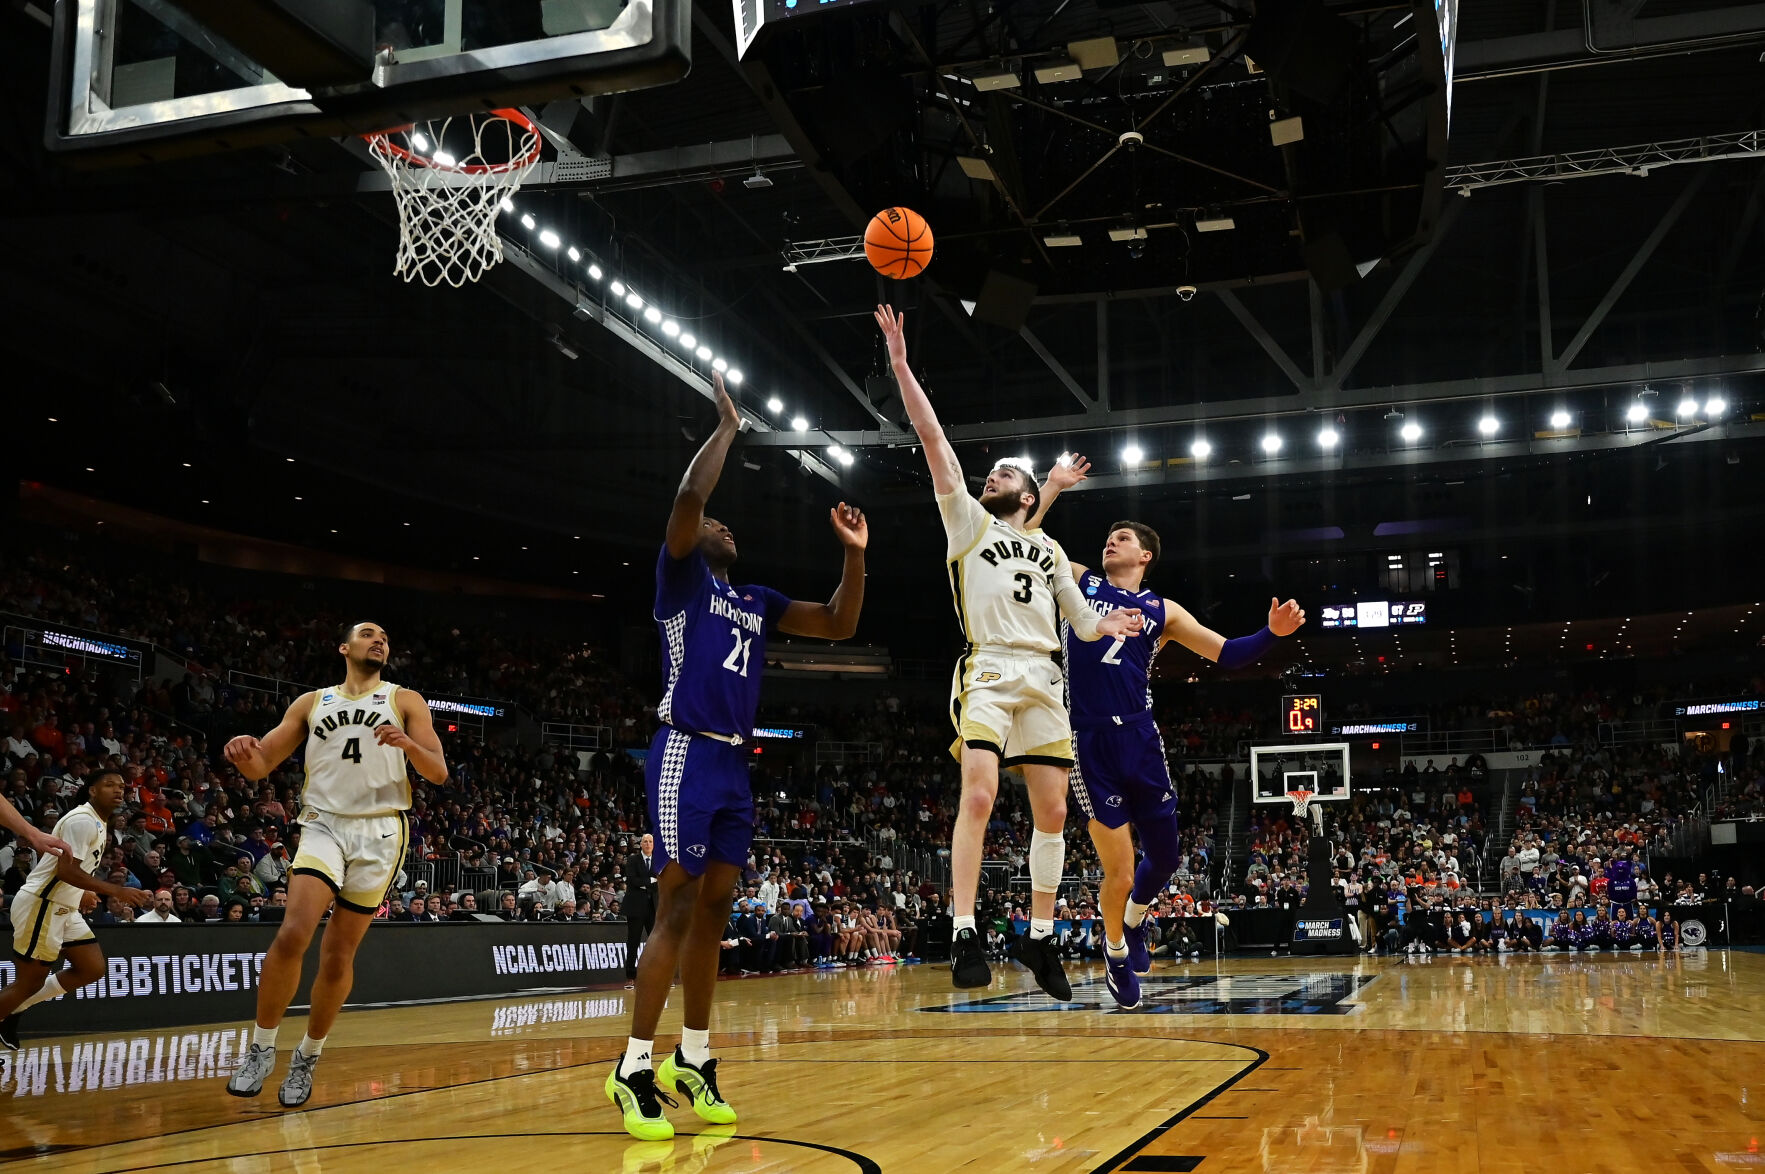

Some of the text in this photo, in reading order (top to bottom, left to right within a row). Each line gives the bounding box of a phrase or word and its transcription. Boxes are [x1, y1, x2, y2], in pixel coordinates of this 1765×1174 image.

[1014, 573, 1032, 604] 3
[723, 628, 752, 677] 21
[1100, 634, 1126, 666] 2
[1293, 698, 1318, 711] 3:29
[1686, 700, 1760, 716] MARCHMADNESS
[1341, 723, 1407, 735] MARCHMADNESS
[341, 737, 362, 763] 4
[1304, 921, 1330, 930] MARCH
[1307, 928, 1342, 937] MADNESS
